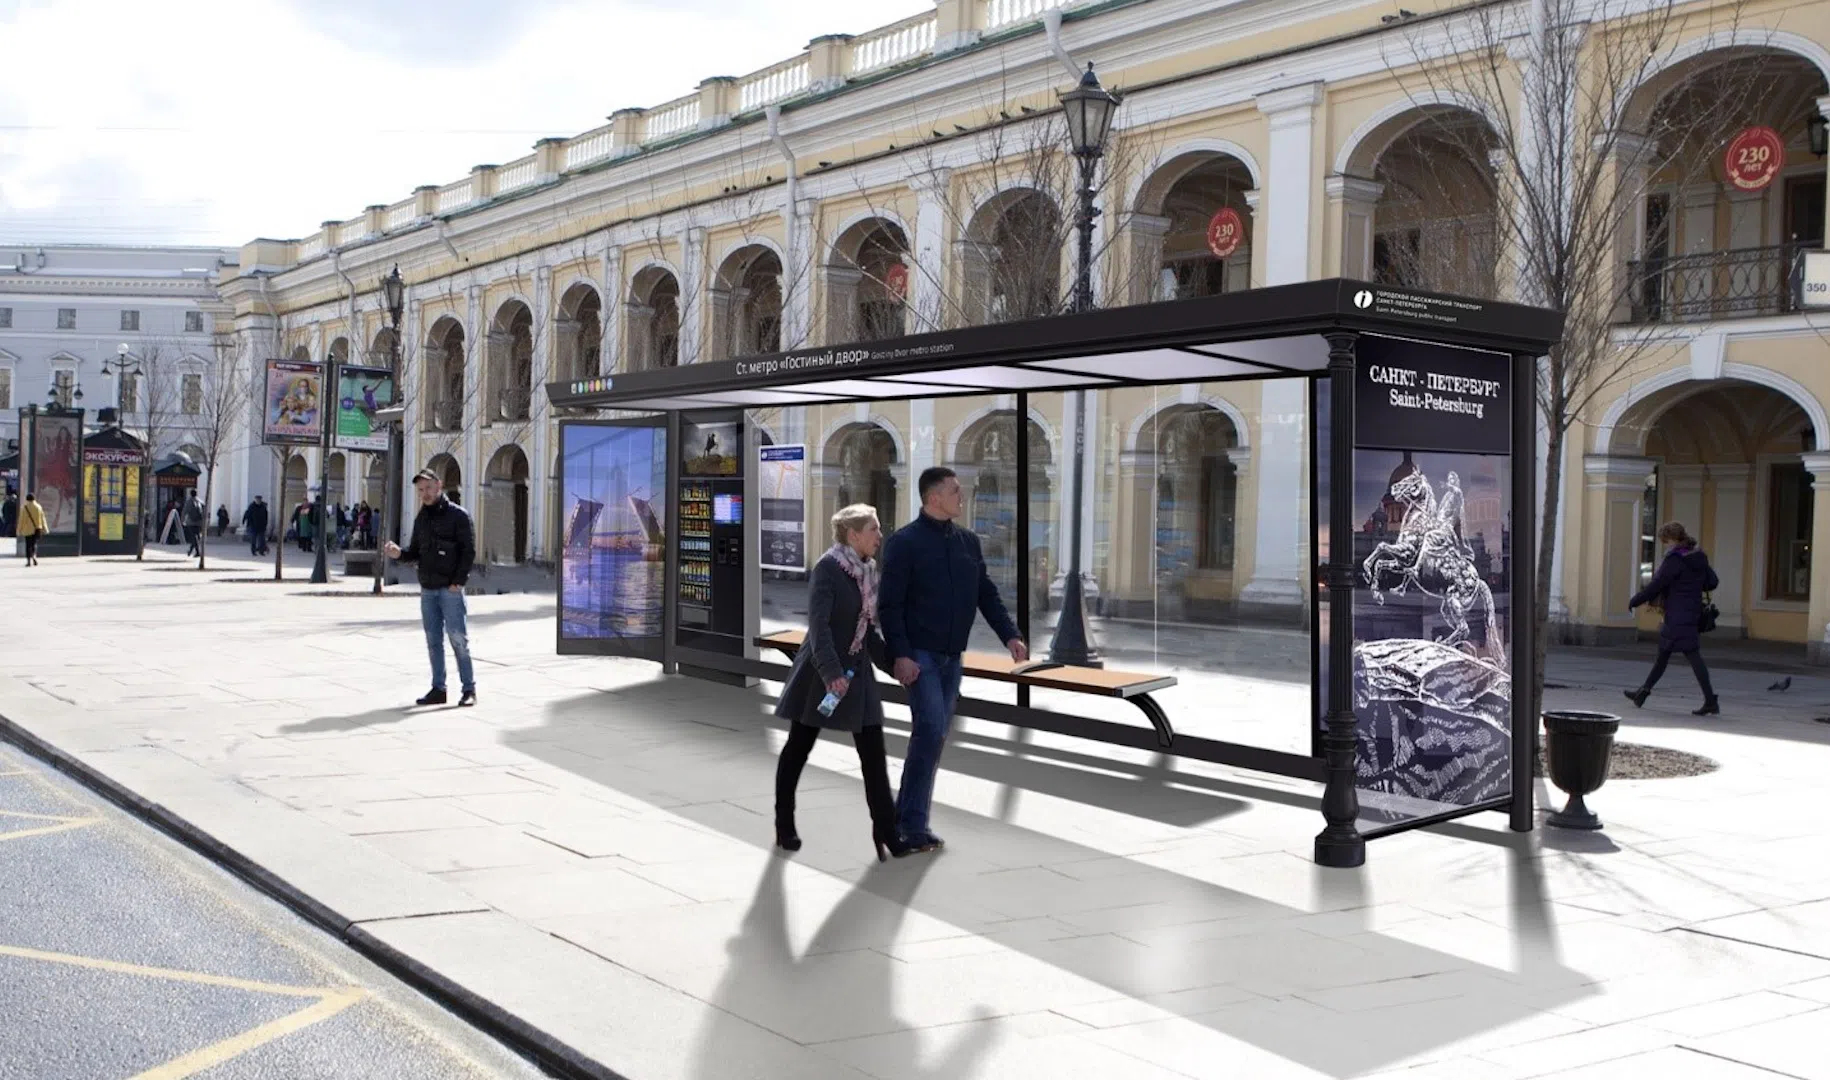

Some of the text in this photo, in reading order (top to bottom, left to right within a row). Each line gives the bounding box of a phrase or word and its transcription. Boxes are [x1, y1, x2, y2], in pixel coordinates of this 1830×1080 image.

[1739, 146, 1769, 164] 230
[1744, 163, 1762, 172] лет
[1216, 224, 1234, 236] 230
[1806, 282, 1827, 292] 350
[735, 350, 870, 375] Ст. метро «Гостиный двор»
[1369, 365, 1417, 387] САНКТ
[1427, 372, 1501, 398] ПЕТЕРБУРГ
[1389, 388, 1483, 418] Saint-Petersburg
[85, 451, 143, 463] ЭКСКУРСИИ
